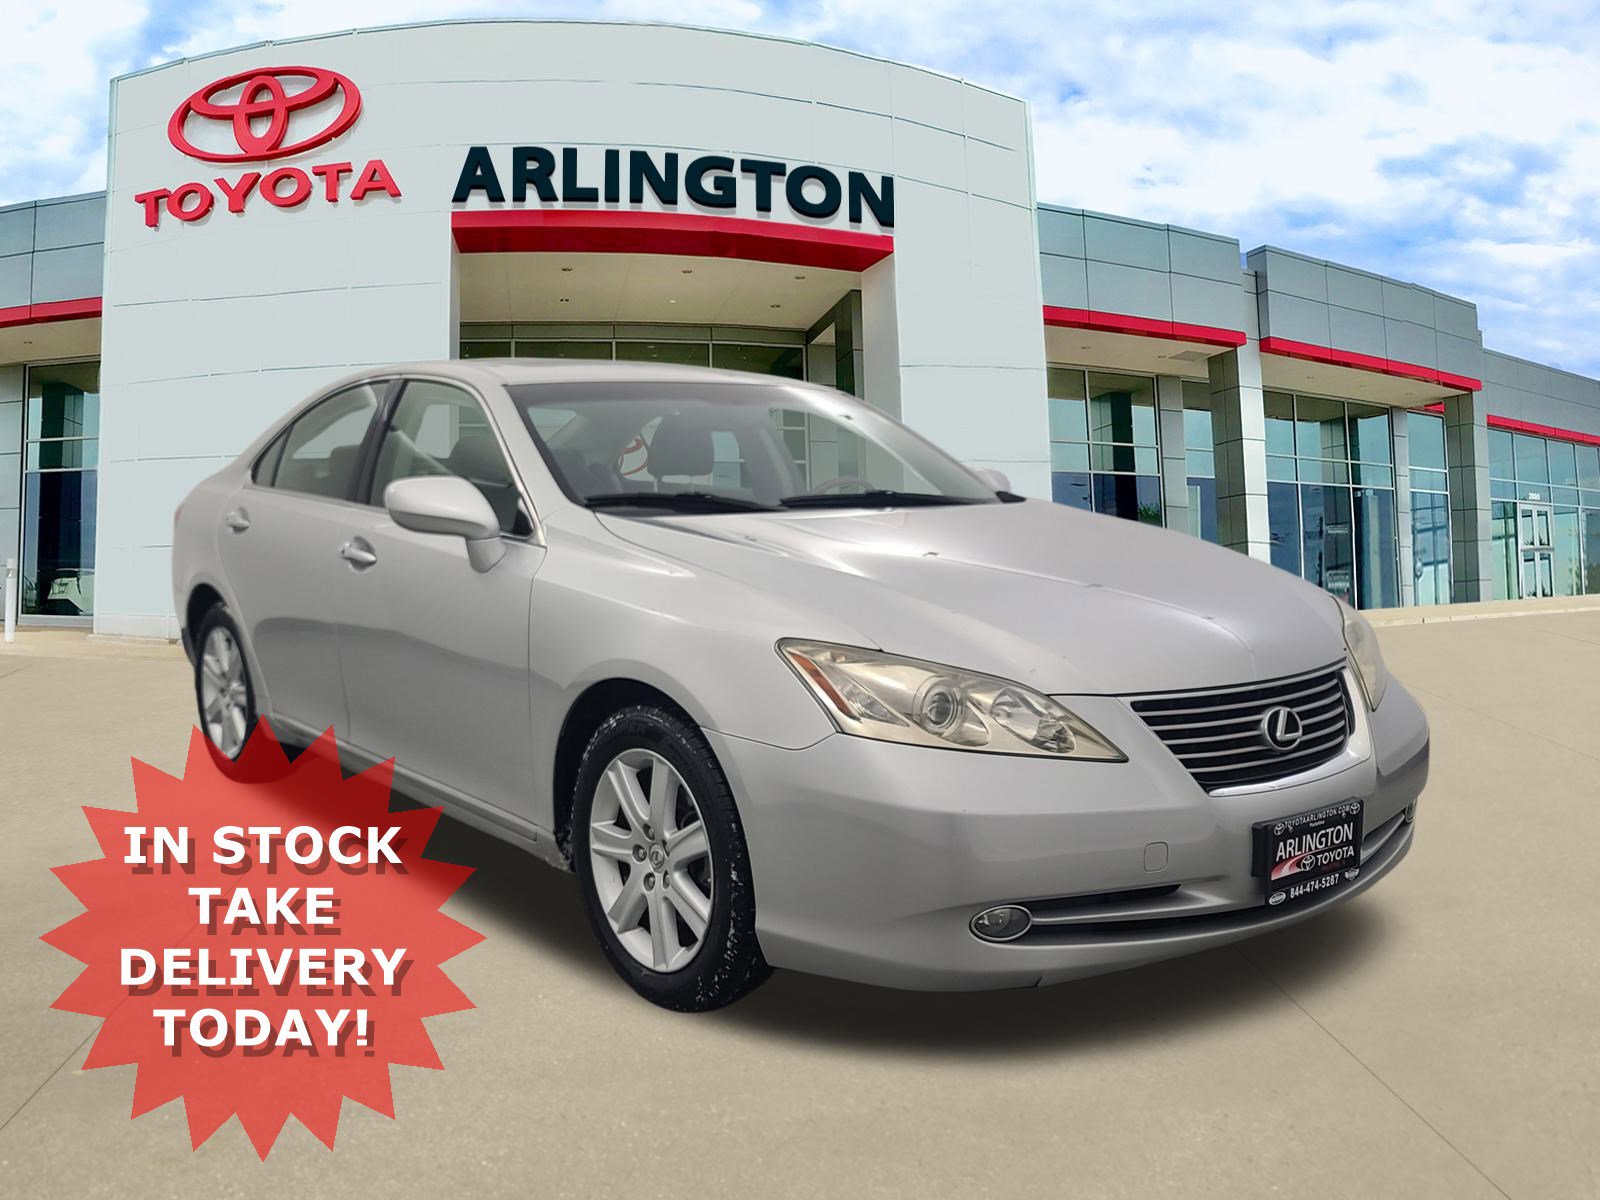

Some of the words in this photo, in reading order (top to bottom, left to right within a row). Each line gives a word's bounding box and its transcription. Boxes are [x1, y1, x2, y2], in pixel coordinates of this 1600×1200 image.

[134, 159, 402, 228] TOYOTA
[451, 146, 895, 228] ARLINGTON
[1276, 822, 1354, 862] ARLINGTON
[1316, 846, 1355, 867] TOYOTA
[1289, 873, 1340, 899] 844-474-5287
